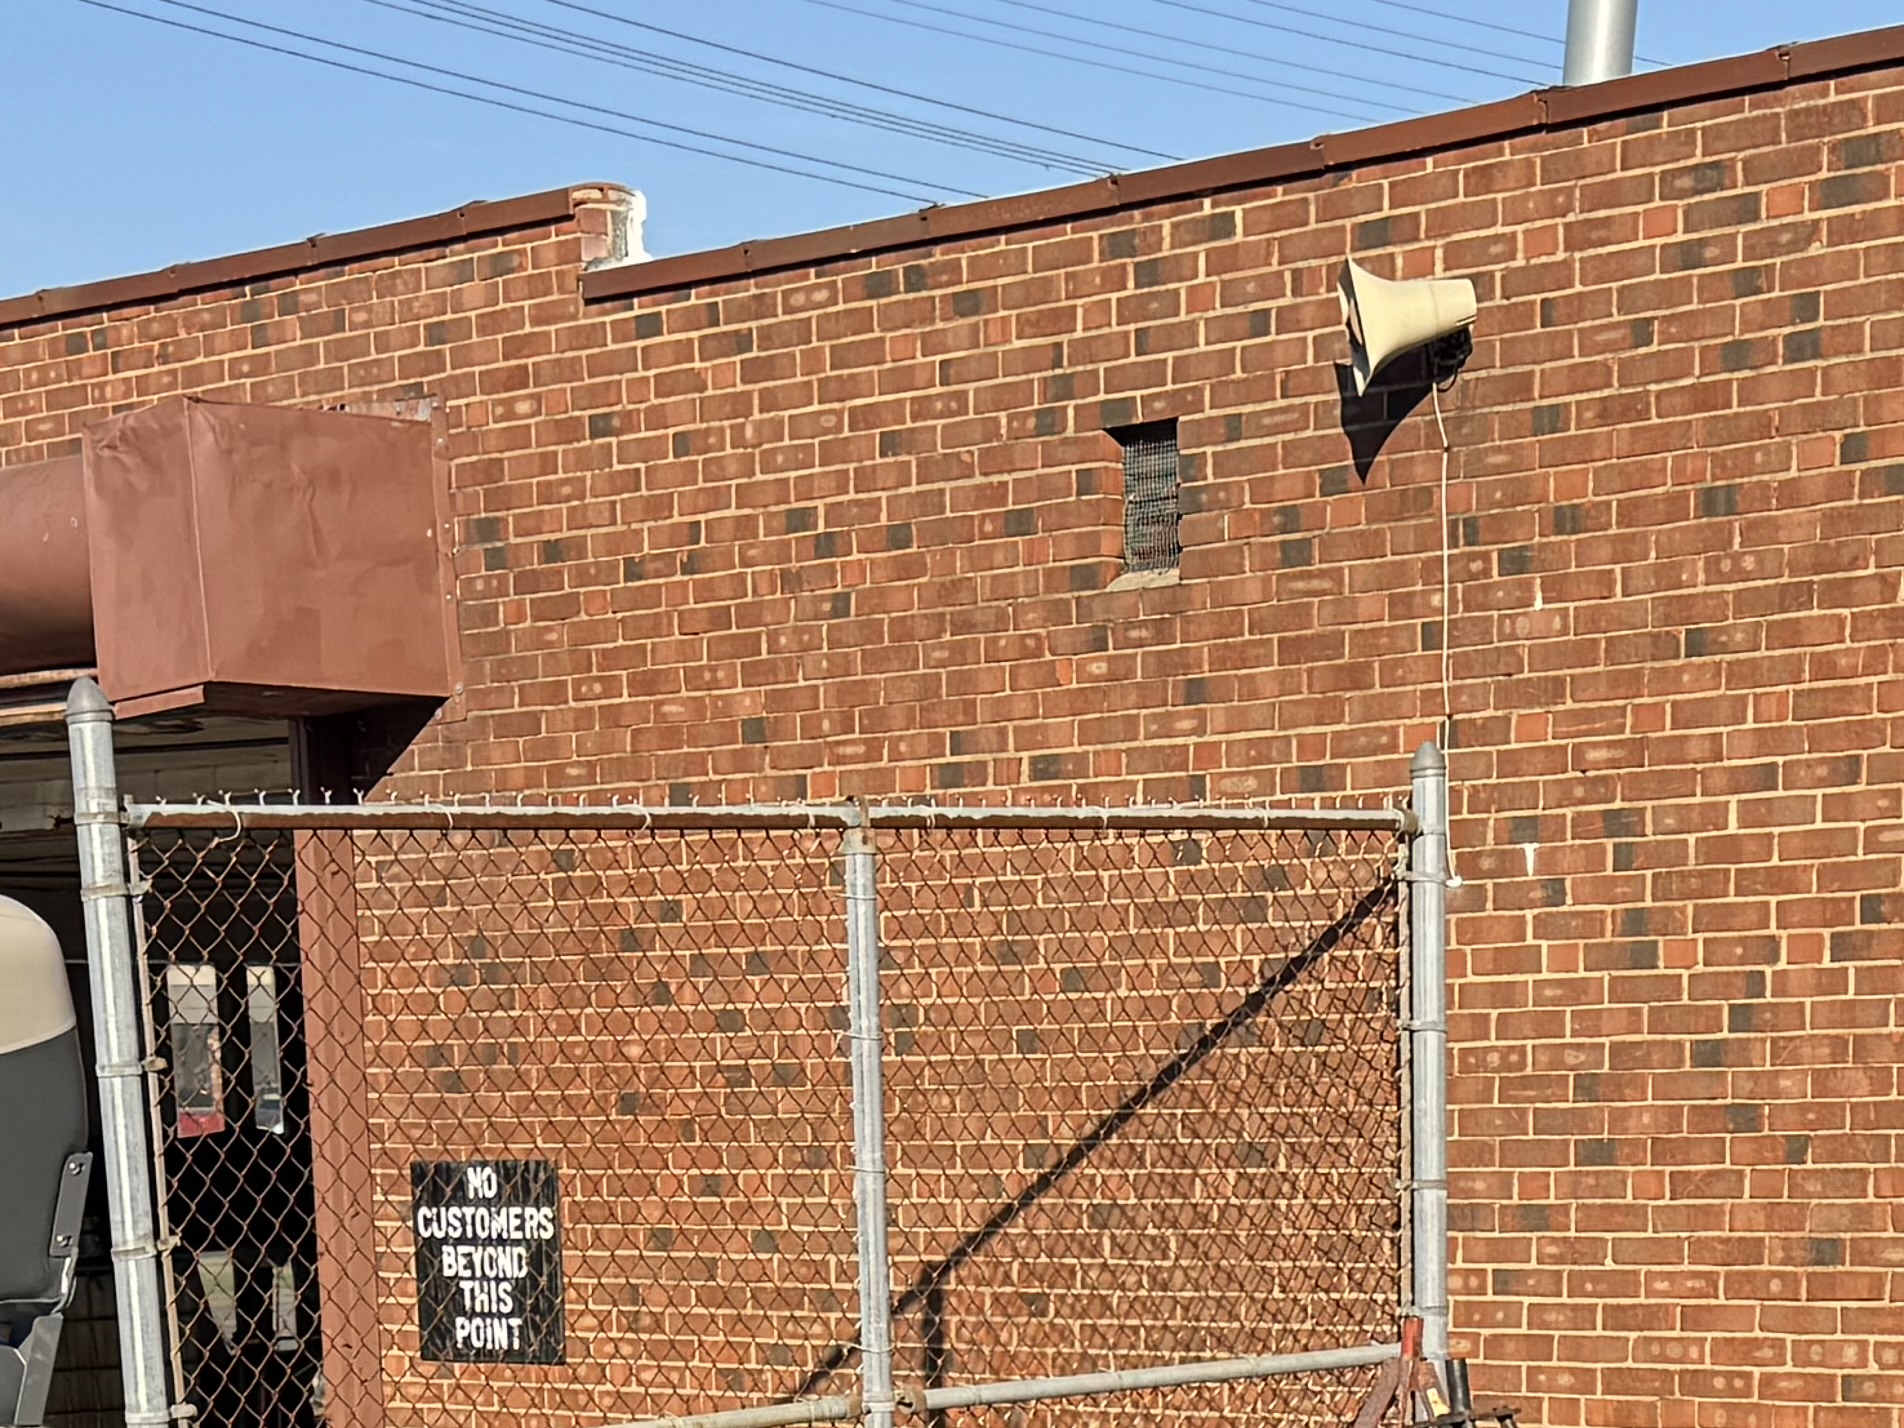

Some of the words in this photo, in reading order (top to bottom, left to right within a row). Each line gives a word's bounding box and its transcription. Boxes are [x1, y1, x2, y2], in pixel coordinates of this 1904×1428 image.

[467, 1166, 498, 1199] NO
[417, 1206, 554, 1240] CUSTOMERS
[442, 1245, 528, 1278] BEYOND
[459, 1280, 514, 1313] THIS
[455, 1316, 522, 1350] POINT
